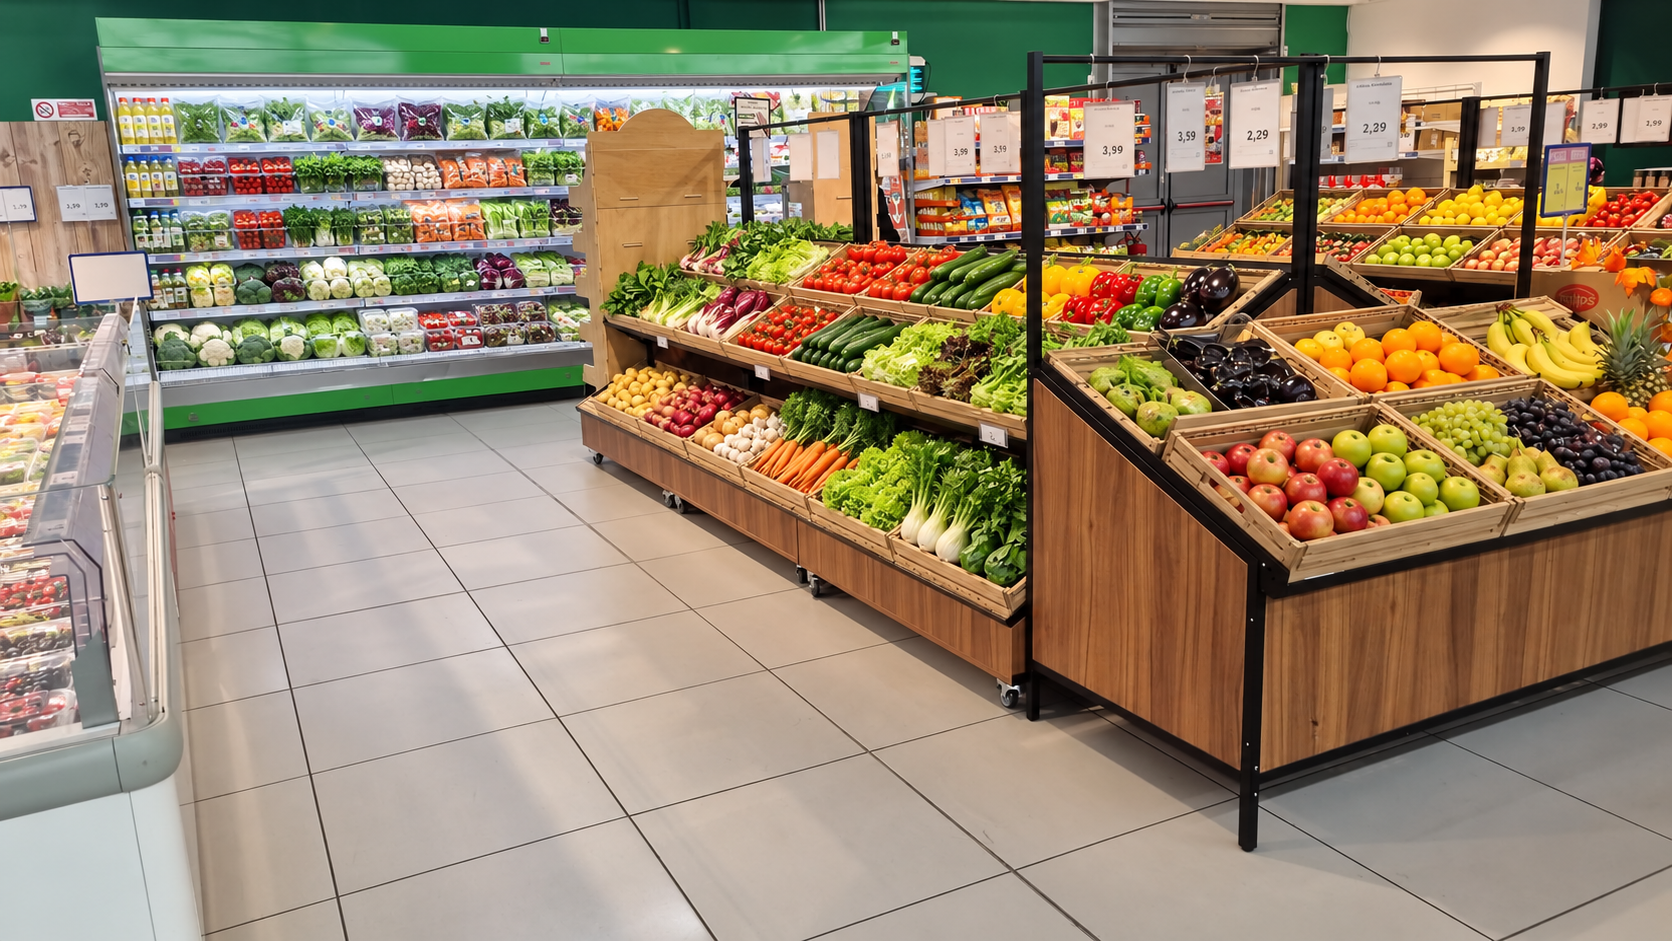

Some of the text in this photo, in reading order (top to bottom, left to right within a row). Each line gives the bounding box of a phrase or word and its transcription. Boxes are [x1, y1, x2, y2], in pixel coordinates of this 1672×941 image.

[1178, 131, 1196, 143] 3,59
[1247, 130, 1268, 142] 2,29
[1102, 145, 1123, 156] 3,99
